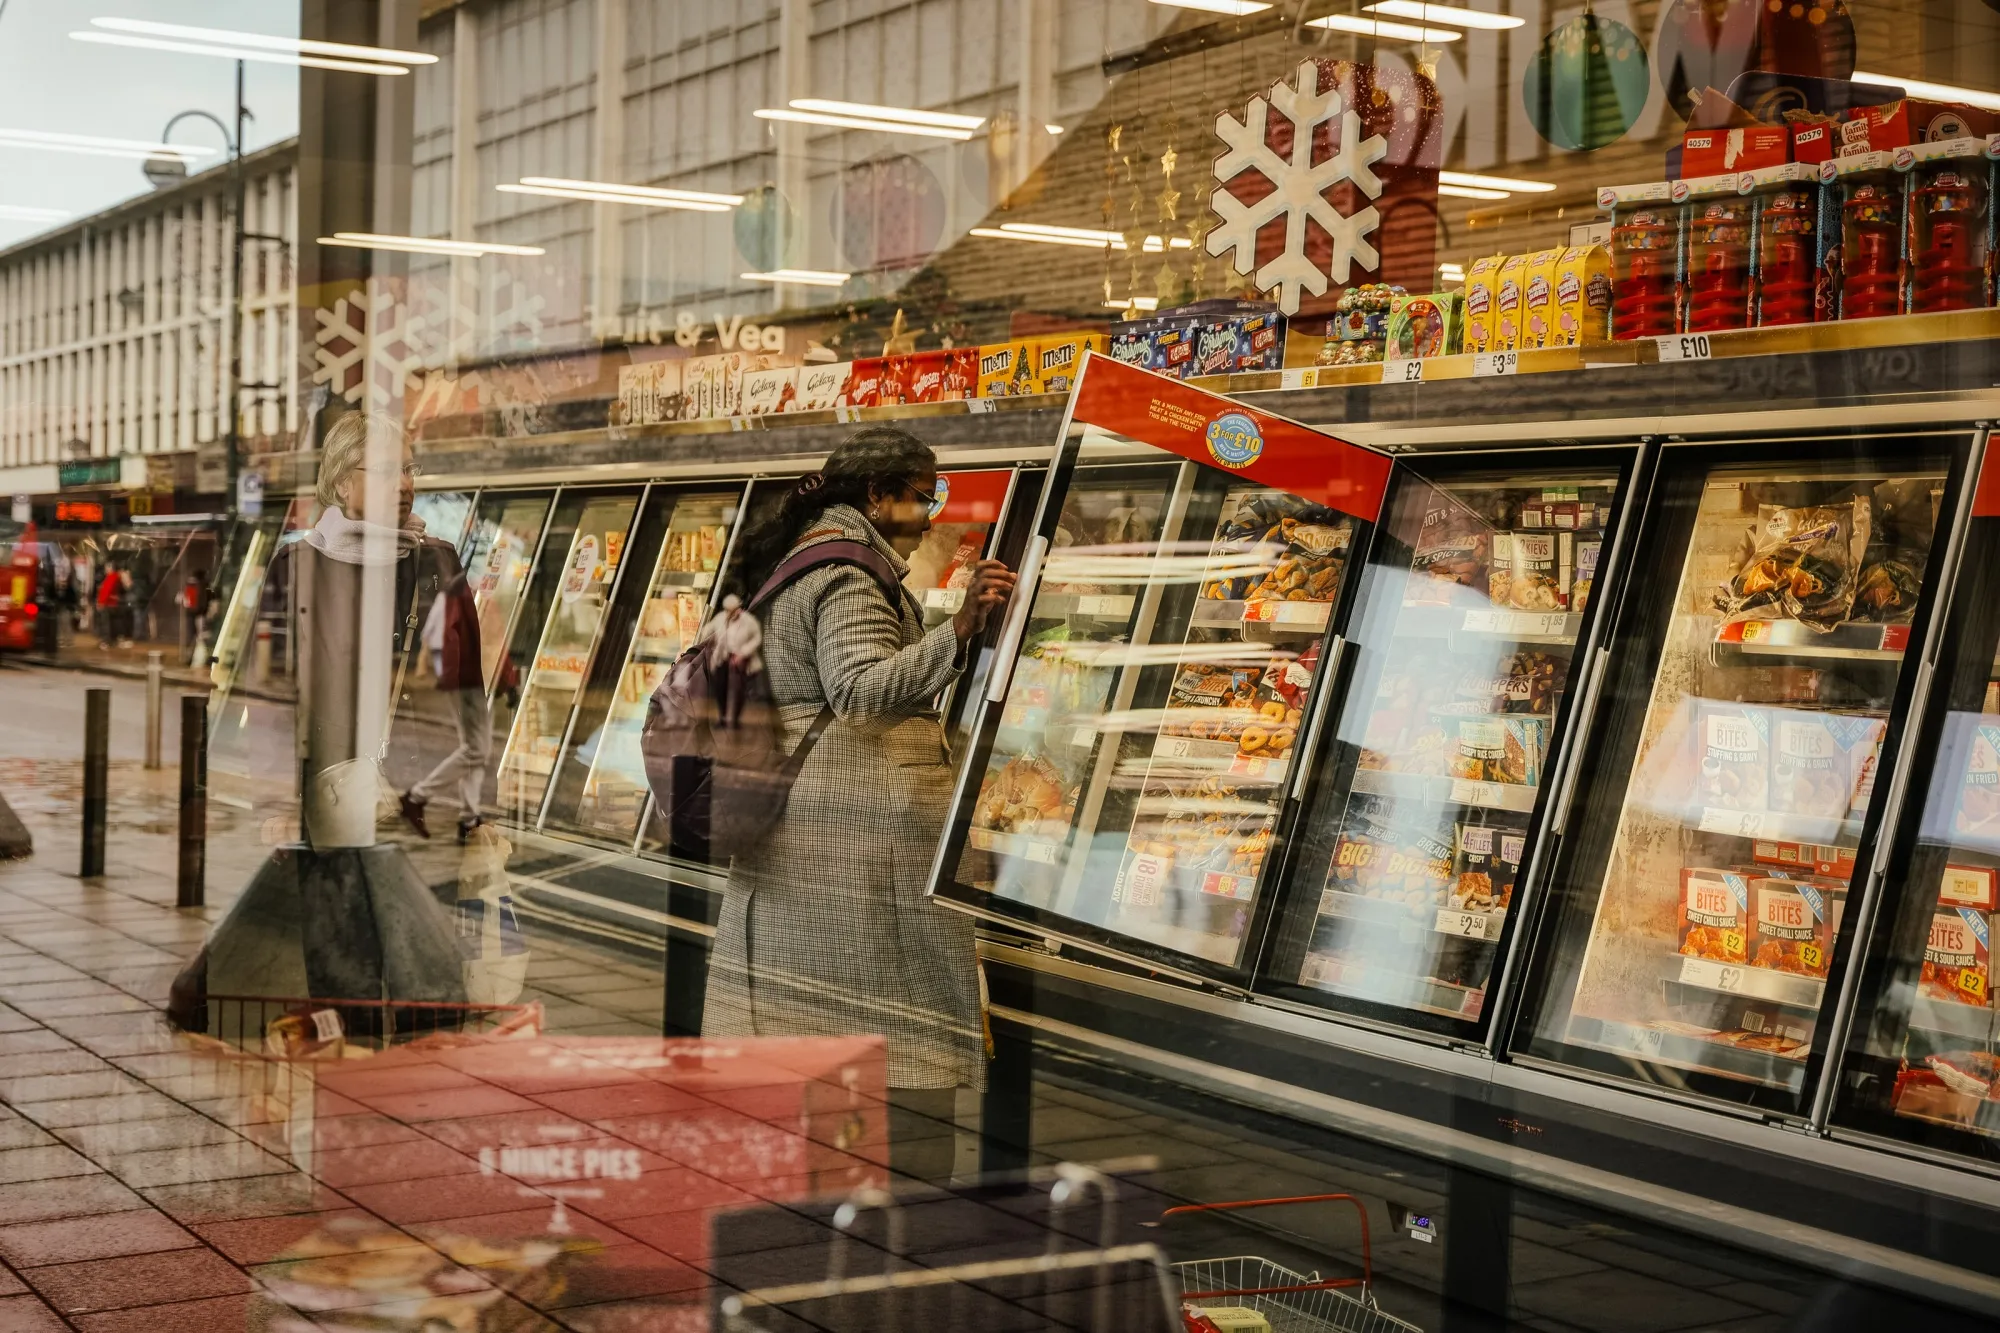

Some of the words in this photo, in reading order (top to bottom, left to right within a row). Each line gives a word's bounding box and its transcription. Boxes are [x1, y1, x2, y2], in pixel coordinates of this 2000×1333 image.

[1688, 138, 1712, 148] 40579
[1797, 130, 1822, 143] 40579
[1680, 336, 1708, 358] £10
[1405, 361, 1421, 381] £2
[1492, 354, 1516, 374] £3.50
[750, 378, 776, 398] Galaxy
[808, 372, 836, 391] Galaxy
[1304, 376, 1312, 384] £1
[1152, 398, 1161, 406] MIX
[1166, 404, 1183, 413] MATCH
[1148, 411, 1160, 420] THIS
[1169, 418, 1179, 426] THE
[1180, 422, 1198, 432] TICKET
[1150, 404, 1164, 413] MEAT
[1169, 412, 1189, 423] CHICKEN
[1189, 419, 1202, 428] WITH
[1211, 424, 1221, 439] 3
[1221, 429, 1234, 441] FOR
[1234, 432, 1261, 453] £10
[1432, 550, 1460, 563] SPICY
[1526, 543, 1548, 555] KIEVS
[1582, 548, 1588, 565] 2
[1535, 561, 1540, 570] &
[1540, 562, 1552, 570] HAM
[1541, 615, 1563, 633] £1.85
[1745, 629, 1757, 638] £10
[1752, 714, 1768, 733] NEW
[1826, 722, 1841, 738] NEW
[1717, 729, 1748, 748] BITES
[1790, 734, 1822, 754] BITES
[1460, 746, 1476, 757] CRISPY
[1477, 750, 1488, 759] RICE
[1707, 747, 1733, 761] STUFFING
[1734, 752, 1739, 762] &
[1739, 751, 1758, 762] GRAVY
[1780, 753, 1805, 768] STUFFING
[1806, 758, 1812, 768] &
[1813, 759, 1832, 768] GRAVY
[1862, 755, 1876, 797] BITES
[1975, 774, 1996, 784] FRIED
[1740, 814, 1760, 836] £2
[1416, 836, 1453, 861] BREADE
[1464, 832, 1470, 849] 4
[1470, 838, 1492, 852] FILLETS
[1338, 842, 1373, 866] BIG
[1504, 842, 1510, 858] 4
[1138, 858, 1159, 875] 18
[1386, 853, 1429, 876] BIG
[1469, 855, 1485, 864] CRISPY
[1729, 878, 1746, 899] NEW
[1696, 892, 1726, 913] BITES
[1806, 890, 1822, 911] NEW
[1687, 911, 1703, 924] SWEET
[1703, 914, 1718, 927] CHILLI
[1719, 916, 1736, 927] SAUCE
[1768, 904, 1802, 926] BITES
[1460, 916, 1484, 936] £2.50
[1758, 922, 1776, 936] SWEET
[1777, 926, 1794, 939] CHILLI
[1795, 928, 1813, 940] SAUCE
[1933, 921, 1948, 929] ICKEN
[1949, 923, 1964, 931] THIGH
[1967, 913, 1986, 936] NEW
[1726, 934, 1740, 950] £2
[1928, 927, 1964, 950] BITES
[1803, 945, 1818, 962] £2
[1924, 950, 1933, 960] EET
[1934, 954, 1940, 962] &
[1939, 953, 1955, 965] SOUR
[1955, 954, 1975, 966] SAUCE
[1719, 968, 1741, 991] £2
[1963, 975, 1980, 991] £2
[500, 1147, 579, 1179] MINCE
[584, 1148, 642, 1180] PIES
